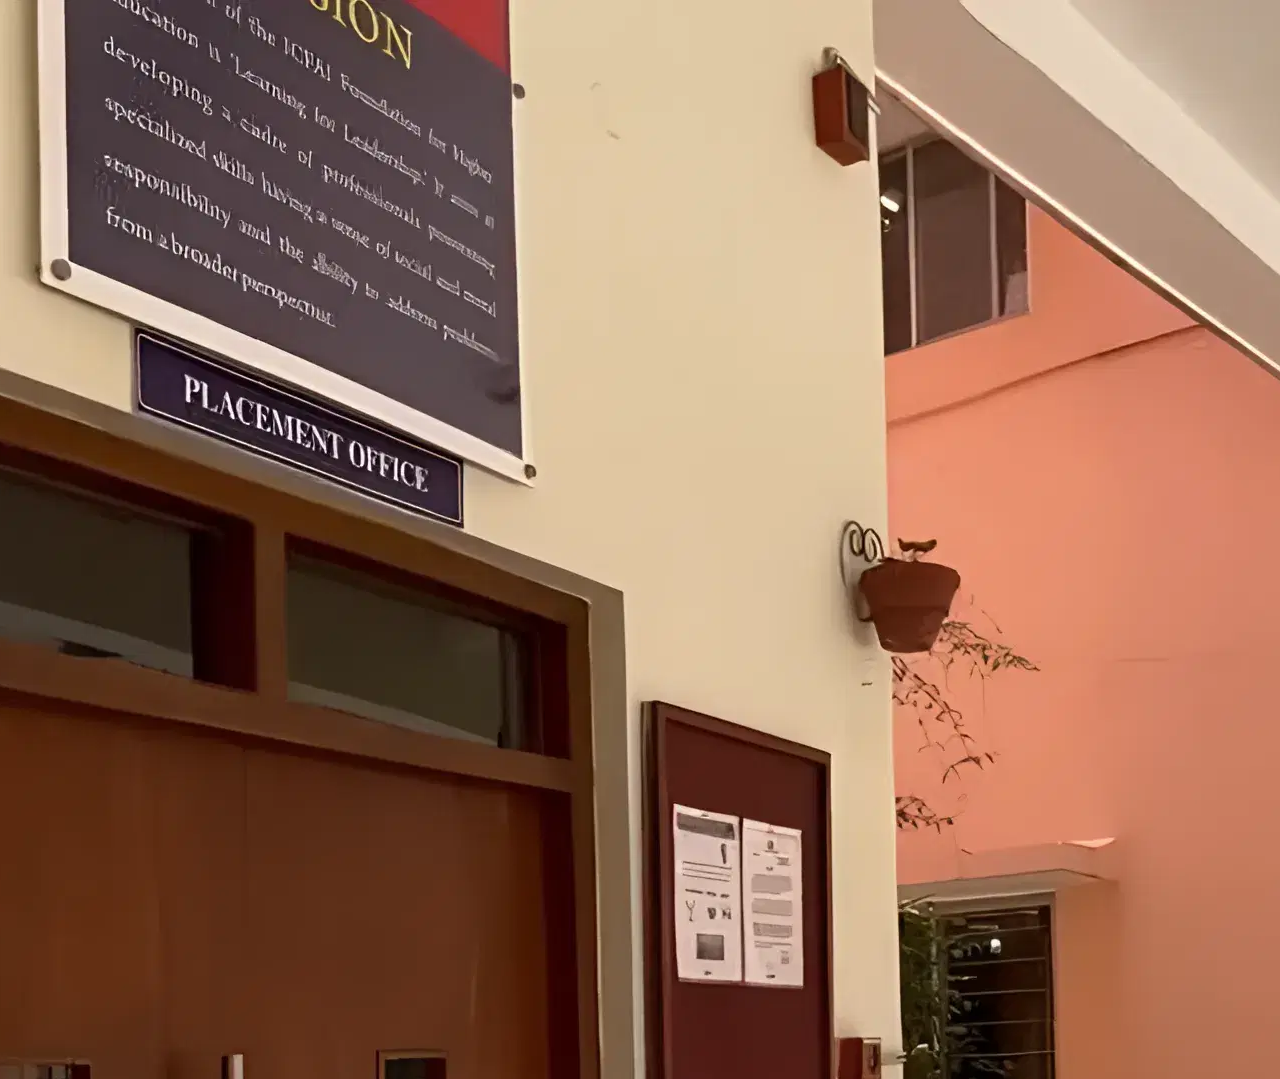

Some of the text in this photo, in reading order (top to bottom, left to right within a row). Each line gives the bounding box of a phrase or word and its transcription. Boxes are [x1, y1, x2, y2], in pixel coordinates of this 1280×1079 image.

[248, 15, 276, 46] the
[104, 36, 213, 115] developing
[298, 150, 313, 169] of
[104, 154, 232, 229] responsibility
[238, 218, 272, 246] and
[278, 235, 304, 265] the
[105, 97, 207, 161] specialized
[212, 150, 255, 185] skills
[376, 240, 391, 260] of
[106, 206, 154, 244] from
[171, 231, 238, 283] broader
[184, 374, 430, 493] PLACEMENT OFFICE
